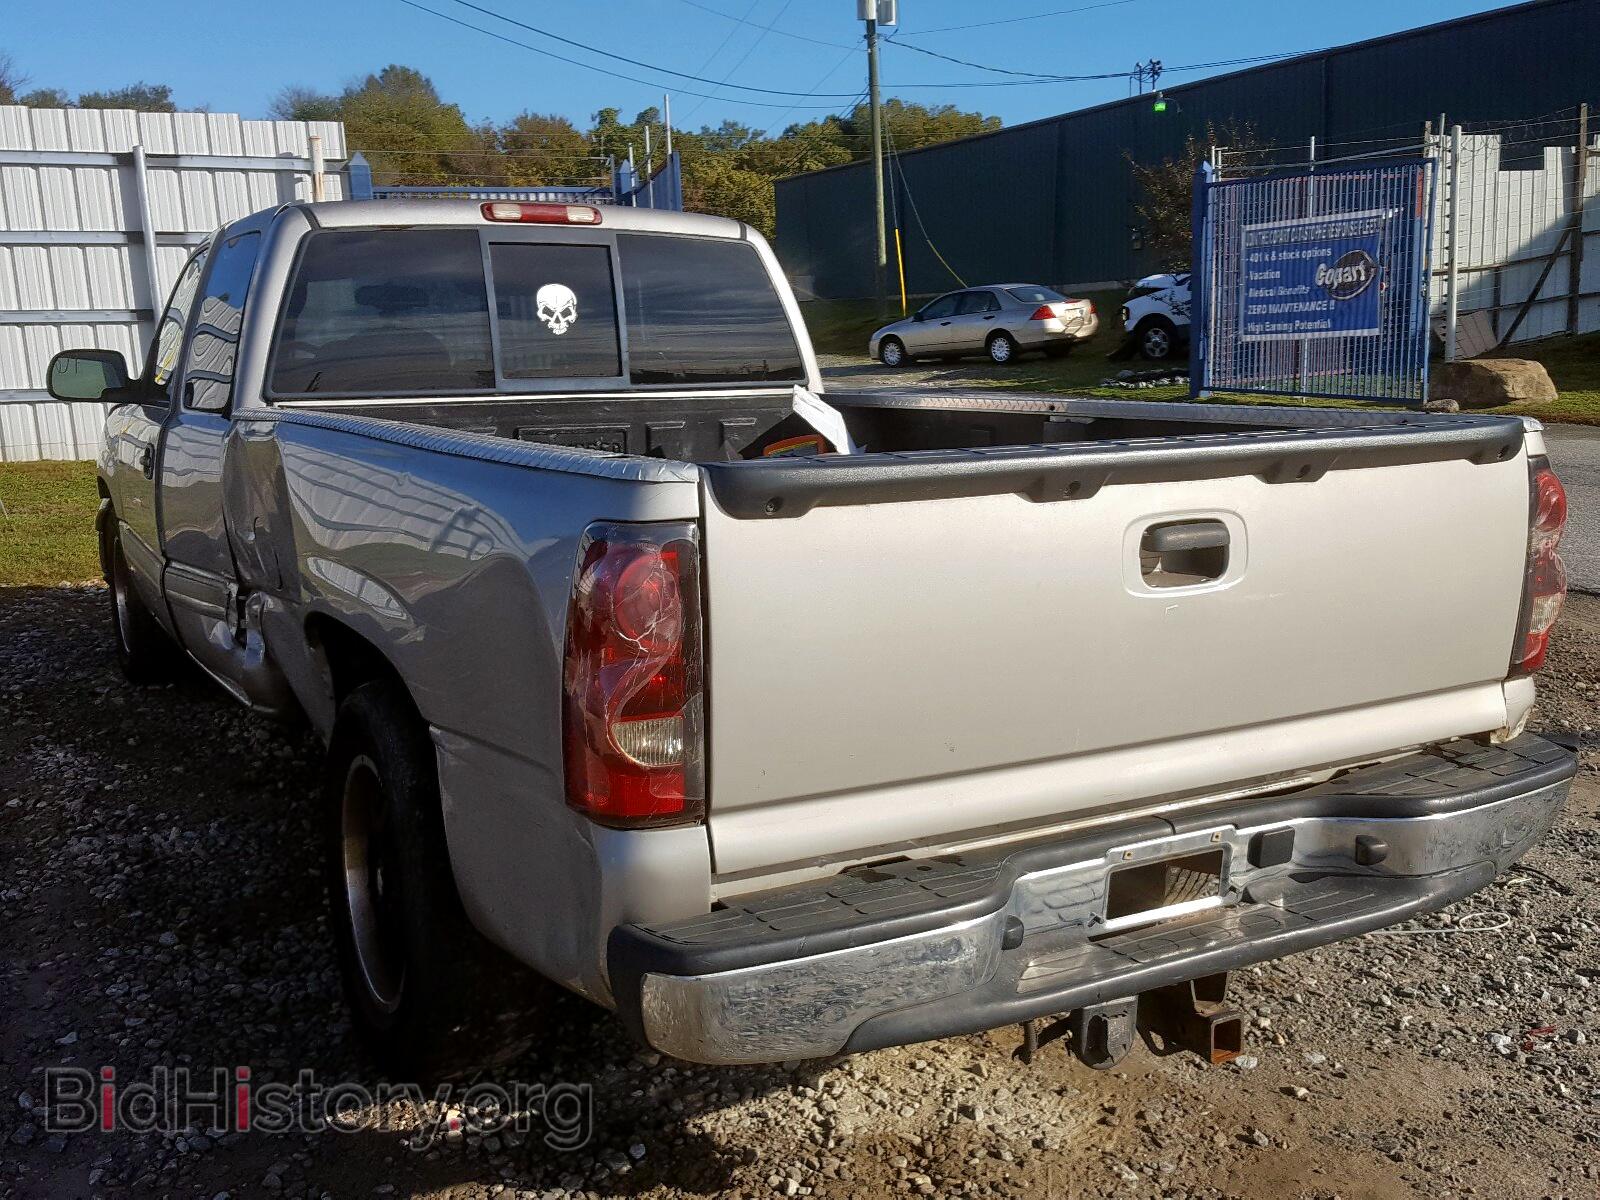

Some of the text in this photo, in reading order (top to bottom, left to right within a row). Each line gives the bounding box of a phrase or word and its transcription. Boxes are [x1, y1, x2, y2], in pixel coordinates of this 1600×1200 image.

[1278, 249, 1300, 260] stock
[1301, 247, 1332, 261] options
[1249, 270, 1280, 280] Vacation
[1315, 261, 1365, 290] Copart
[1248, 286, 1275, 297] Medical
[1247, 304, 1267, 315] ZERO
[1268, 301, 1328, 314] MAINTENANCE
[1247, 318, 1331, 334] High Earning Potential
